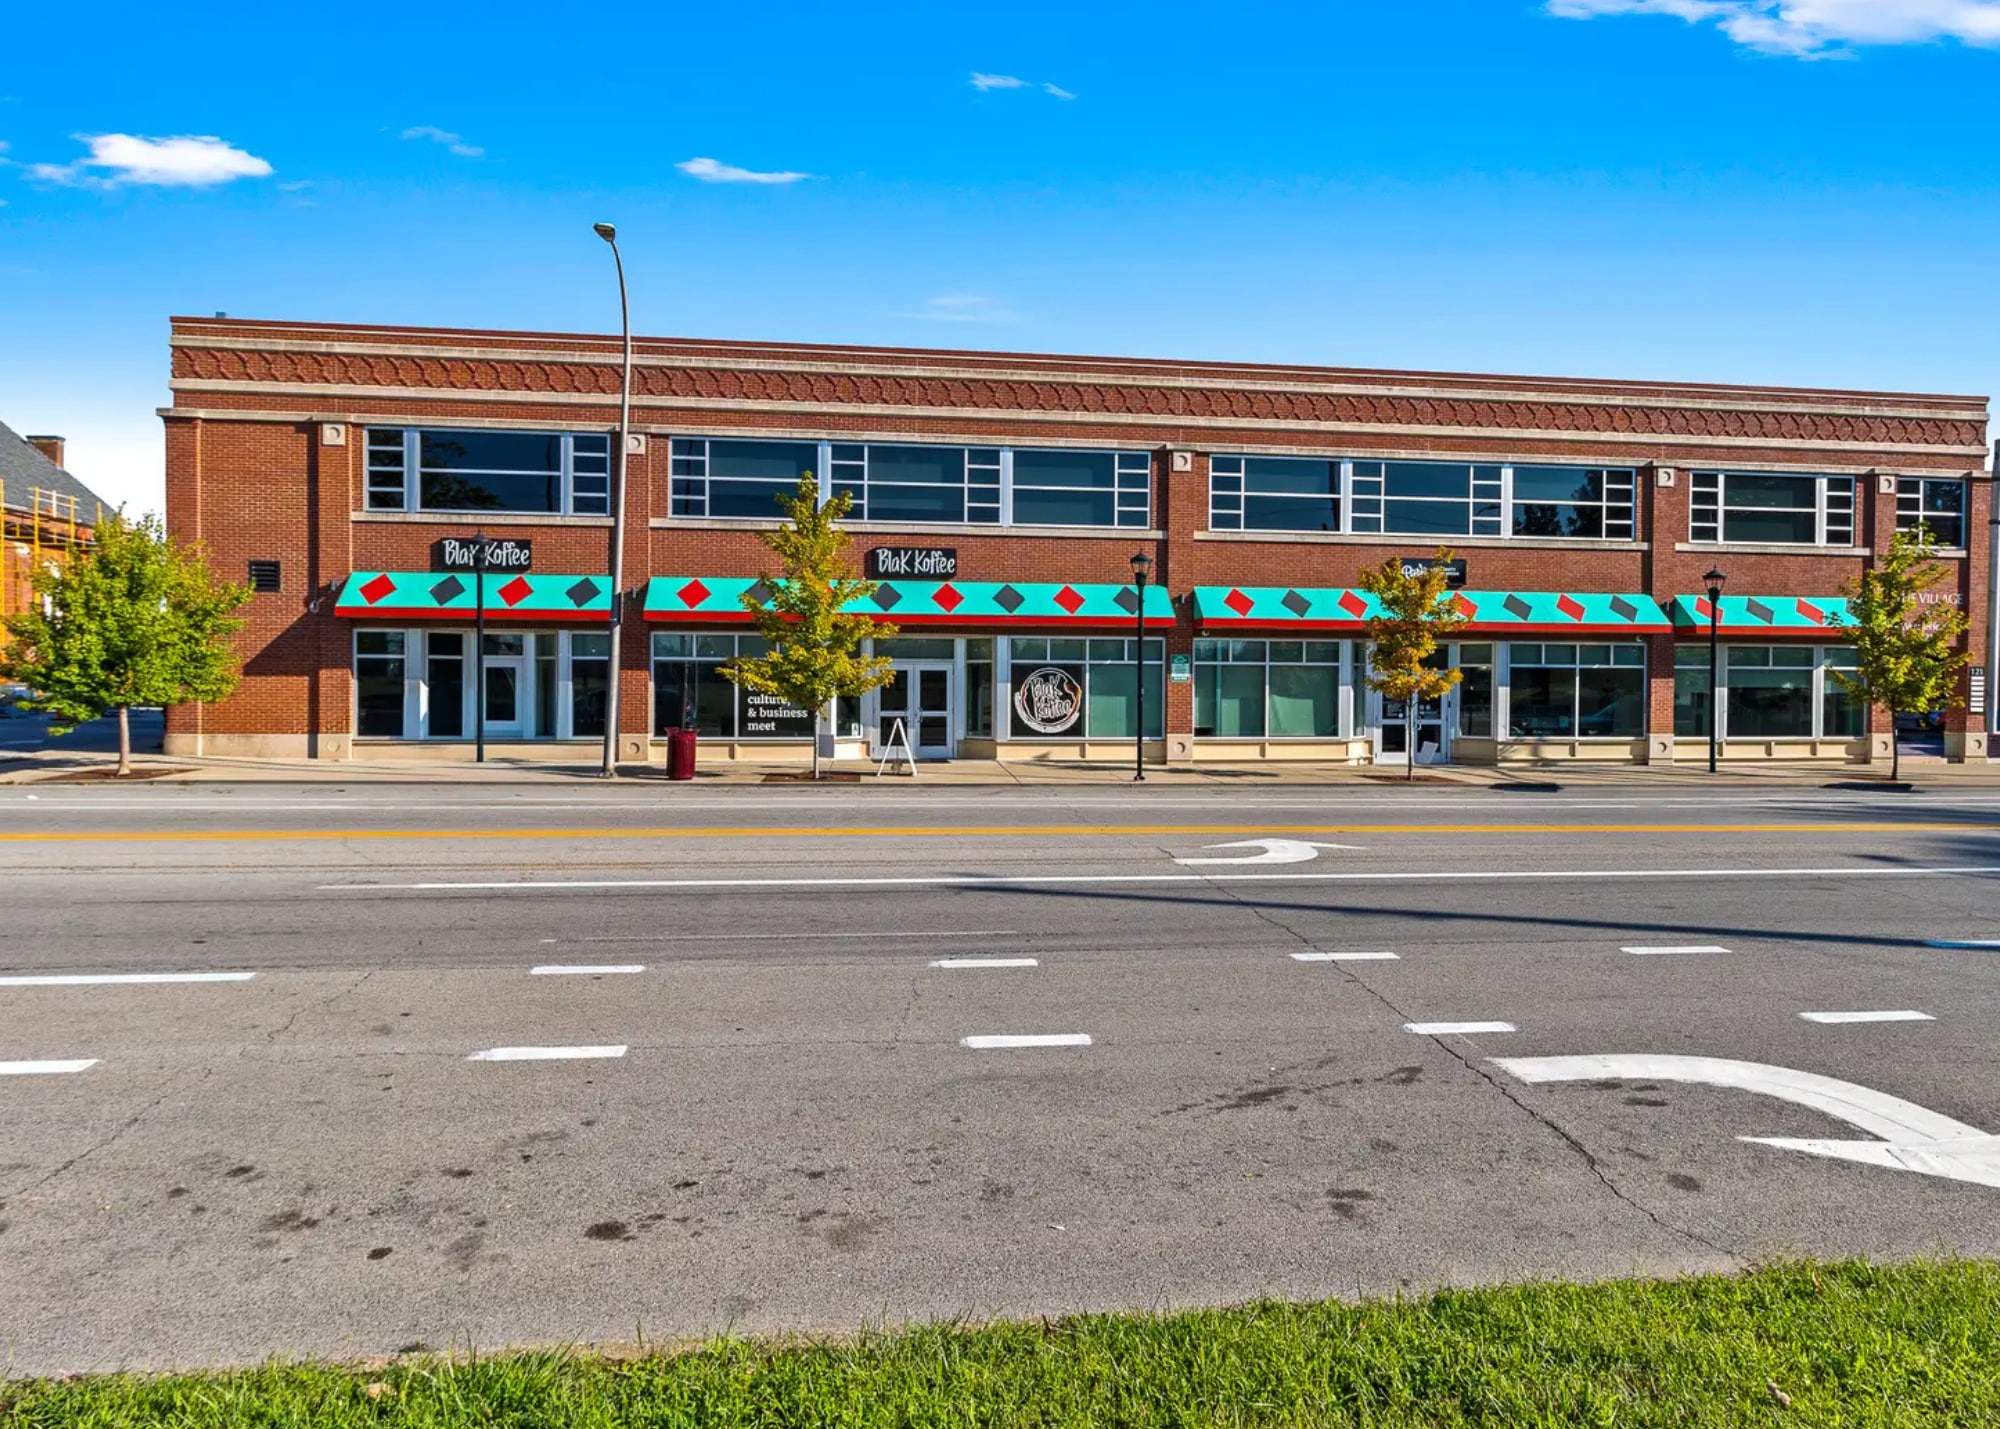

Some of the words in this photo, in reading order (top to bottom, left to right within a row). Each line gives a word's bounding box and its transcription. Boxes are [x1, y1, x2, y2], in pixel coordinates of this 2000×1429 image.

[484, 541, 530, 567] Koffee
[876, 548, 912, 574] BlaK
[914, 549, 955, 574] Koffee
[747, 708, 757, 718] &
[759, 707, 808, 719] business
[747, 720, 776, 731] meet
